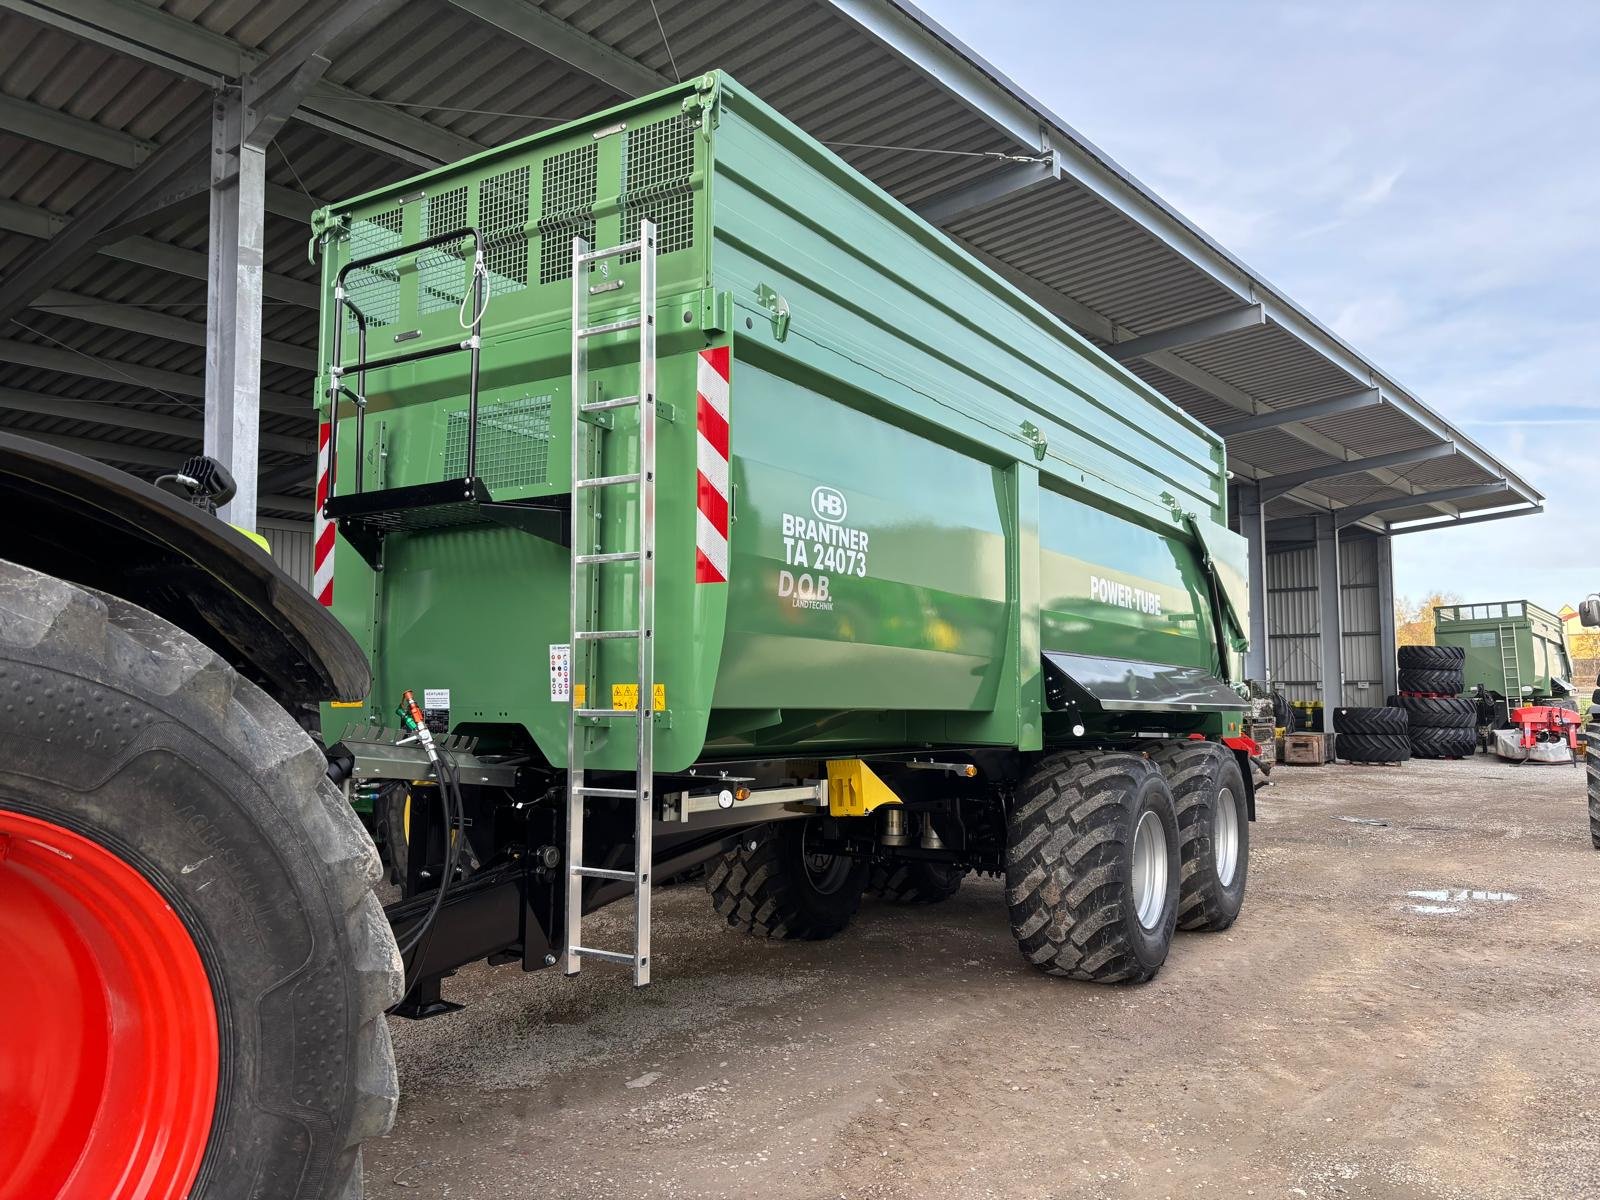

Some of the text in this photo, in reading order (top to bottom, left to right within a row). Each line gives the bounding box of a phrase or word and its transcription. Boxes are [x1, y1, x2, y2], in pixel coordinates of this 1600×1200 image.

[782, 513, 869, 552] BRANTNER
[783, 536, 867, 578] TA 24073
[792, 599, 834, 611] LANDTECHNIK
